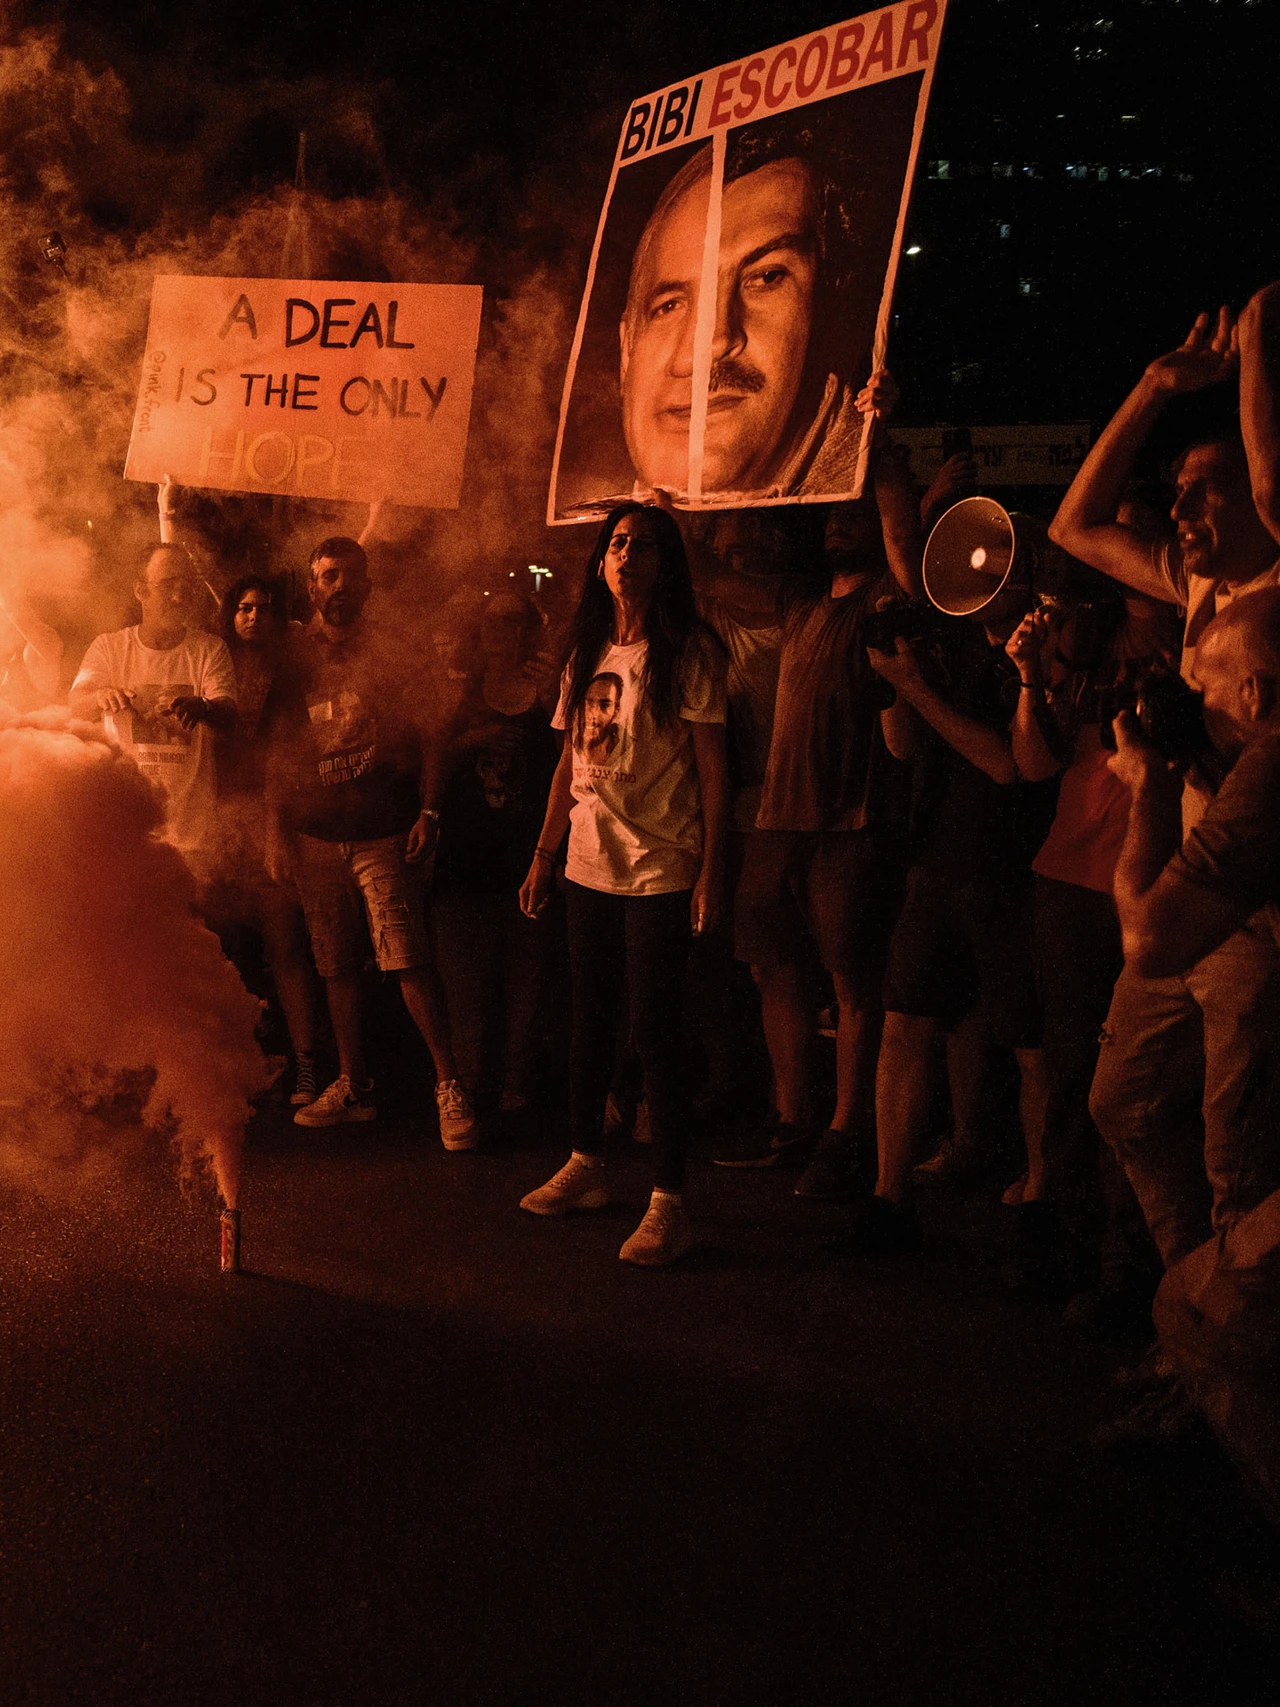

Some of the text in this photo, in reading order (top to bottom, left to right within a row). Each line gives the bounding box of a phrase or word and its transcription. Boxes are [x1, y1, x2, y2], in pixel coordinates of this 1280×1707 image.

[621, 0, 939, 161] BIBI ESCOBAR
[218, 293, 416, 350] A DEAL
[175, 367, 449, 423] IS THE ONLY
[614, 771, 637, 784] מתן
